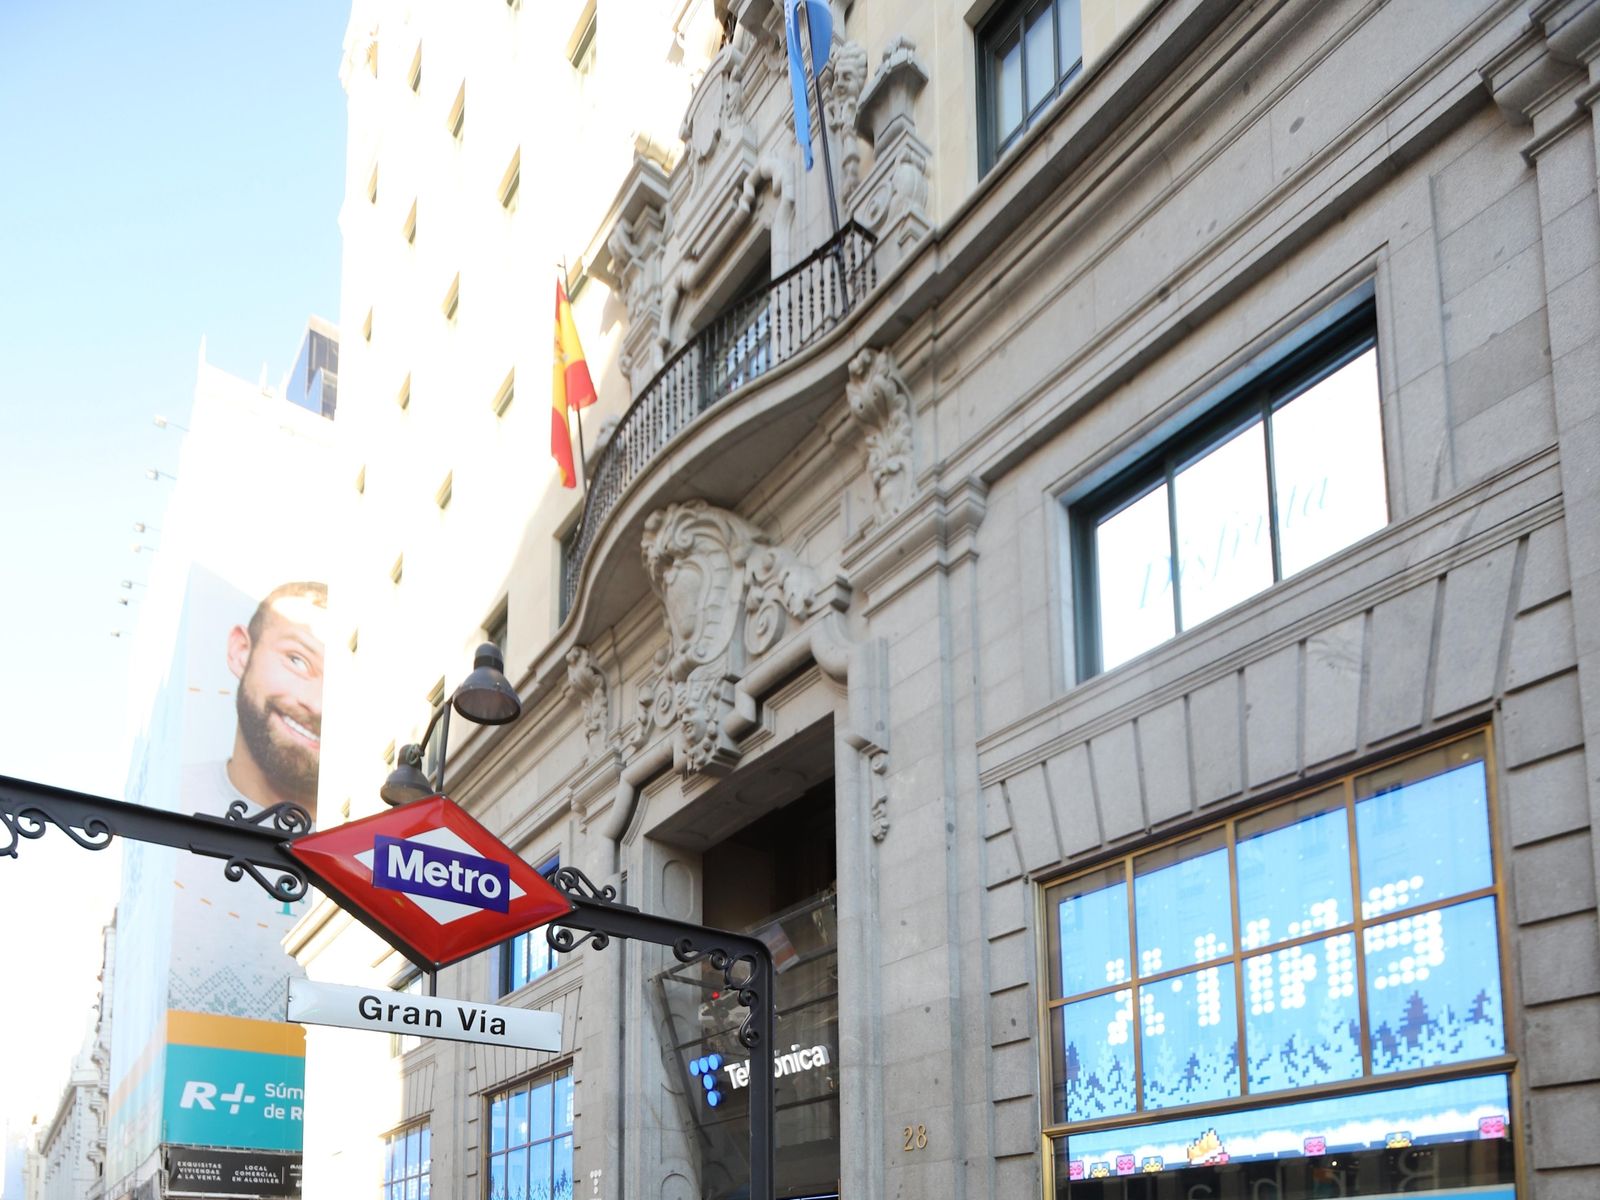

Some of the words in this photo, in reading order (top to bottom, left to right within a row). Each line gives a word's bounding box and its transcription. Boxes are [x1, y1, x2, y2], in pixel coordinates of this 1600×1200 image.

[387, 844, 502, 899] Metro
[358, 995, 442, 1028] Gran
[457, 1007, 506, 1036] Vía
[264, 1103, 285, 1119] de
[290, 1106, 304, 1121] R
[903, 1123, 928, 1152] 28
[177, 1161, 222, 1170] EXQUISITAS
[244, 1164, 267, 1172] LOCAL
[179, 1167, 220, 1175] VIVIENDAS
[234, 1170, 277, 1178] COMERCIAL
[197, 1174, 222, 1182] VENTA
[244, 1176, 280, 1184] ALQUILER
